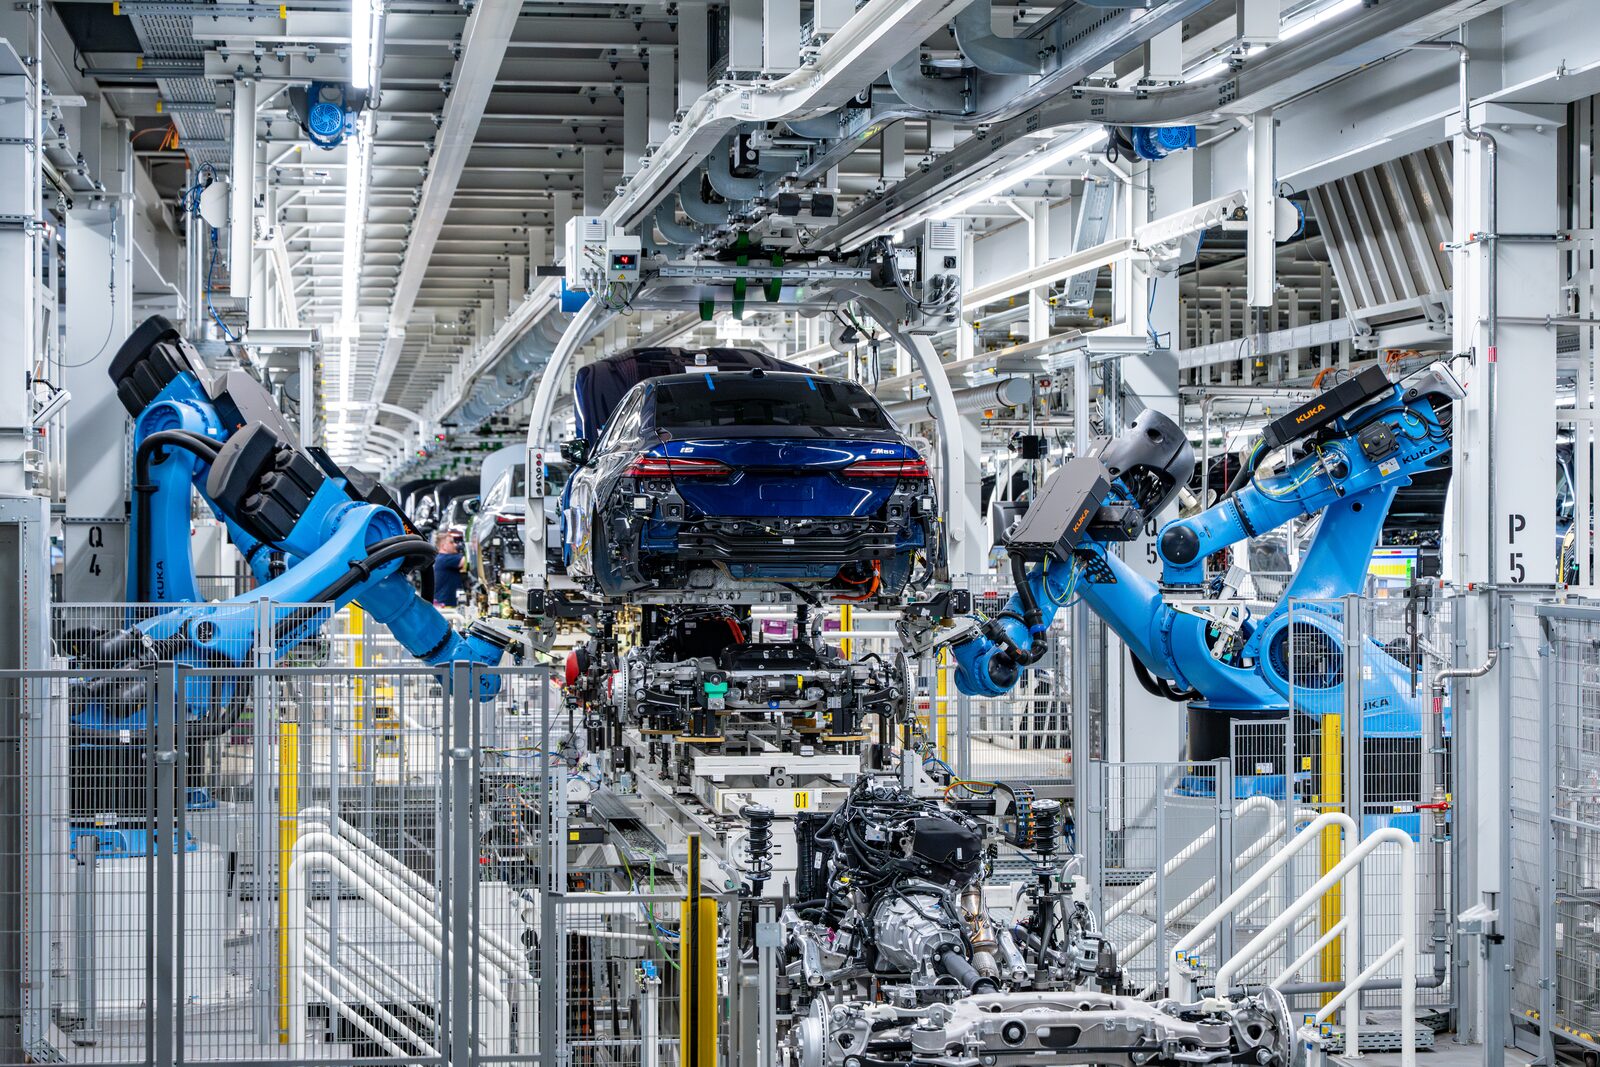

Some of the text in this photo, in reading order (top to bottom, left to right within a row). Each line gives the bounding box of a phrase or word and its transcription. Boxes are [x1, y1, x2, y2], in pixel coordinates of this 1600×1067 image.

[1295, 403, 1327, 424] KUKA
[1401, 445, 1438, 465] KUKA
[1072, 508, 1090, 533] KUKA
[1144, 518, 1158, 537] Q
[1508, 514, 1526, 544] P
[88, 526, 103, 548] Q
[1146, 543, 1158, 564] 5
[89, 553, 101, 576] 4
[1509, 552, 1525, 583] 5
[156, 560, 165, 600] KUKA
[1362, 698, 1389, 711] UKA
[795, 792, 807, 808] 01
